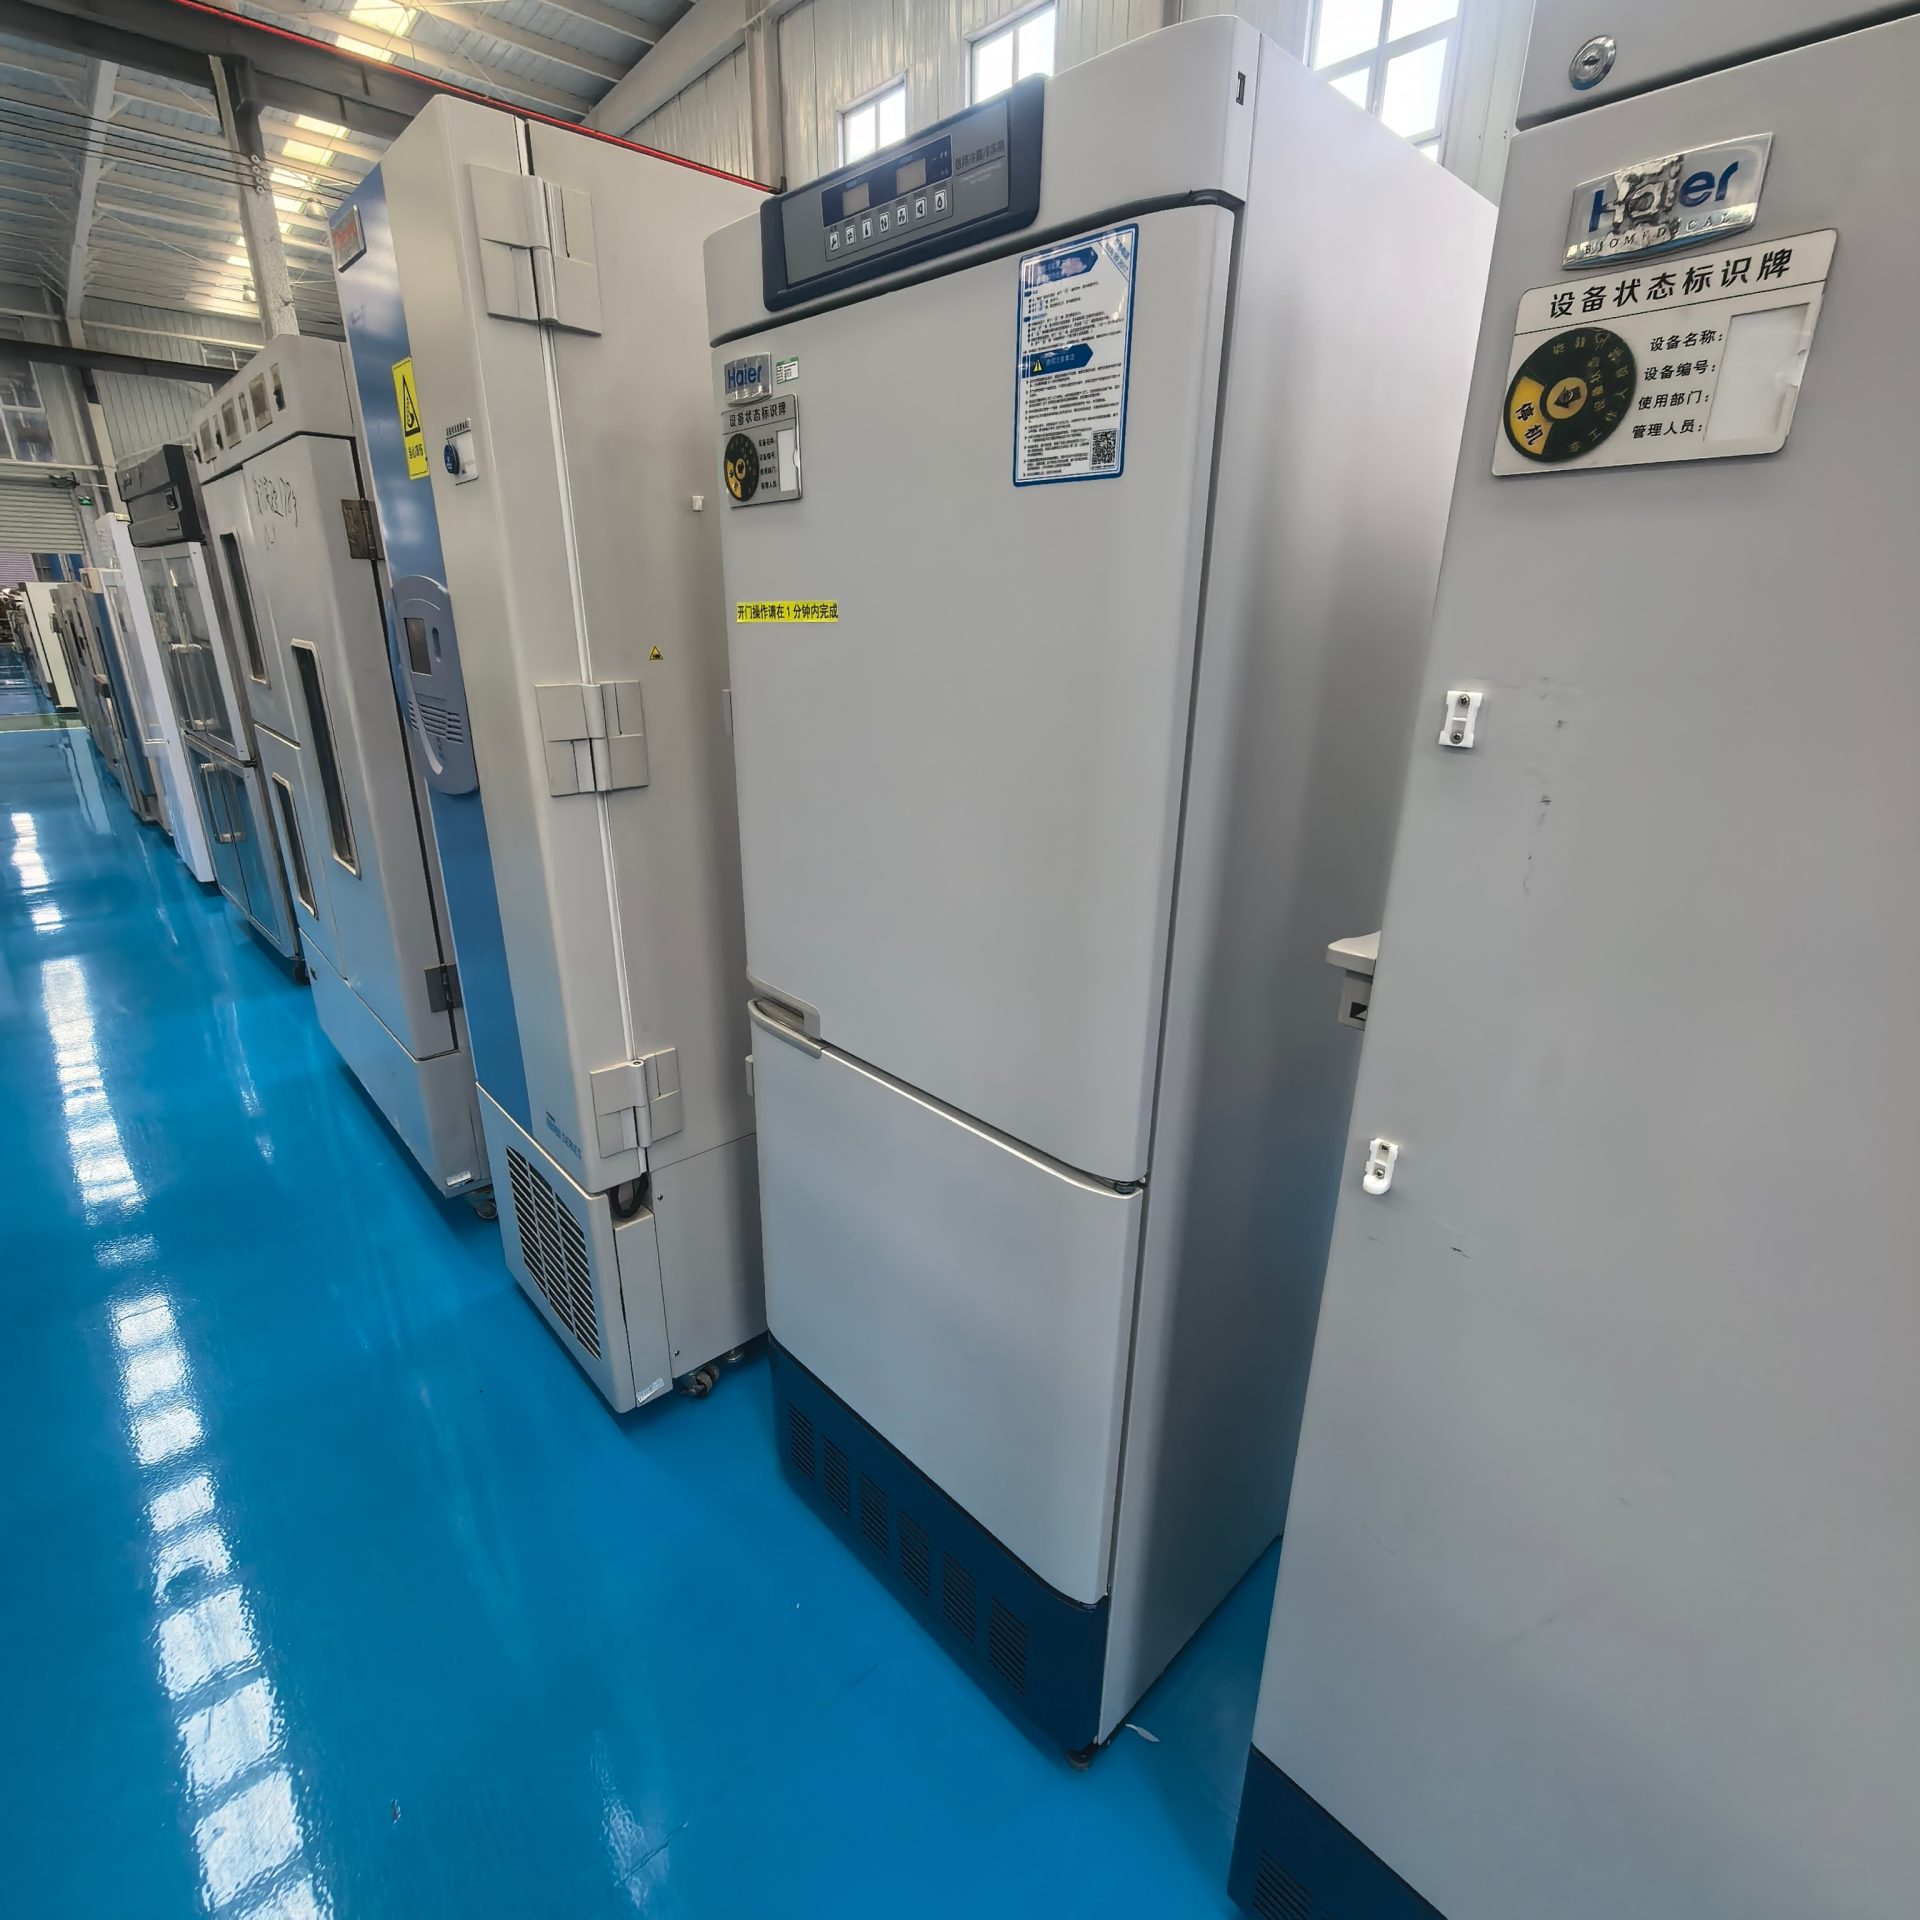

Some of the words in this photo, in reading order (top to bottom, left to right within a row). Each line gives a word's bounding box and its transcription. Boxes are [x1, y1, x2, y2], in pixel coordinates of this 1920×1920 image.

[1588, 160, 1739, 233] Haier
[1549, 248, 1793, 319] 设备状态标识牌
[728, 364, 762, 389] Haier
[729, 401, 786, 428] 设备状态标识牌
[1515, 401, 1544, 446] 停机
